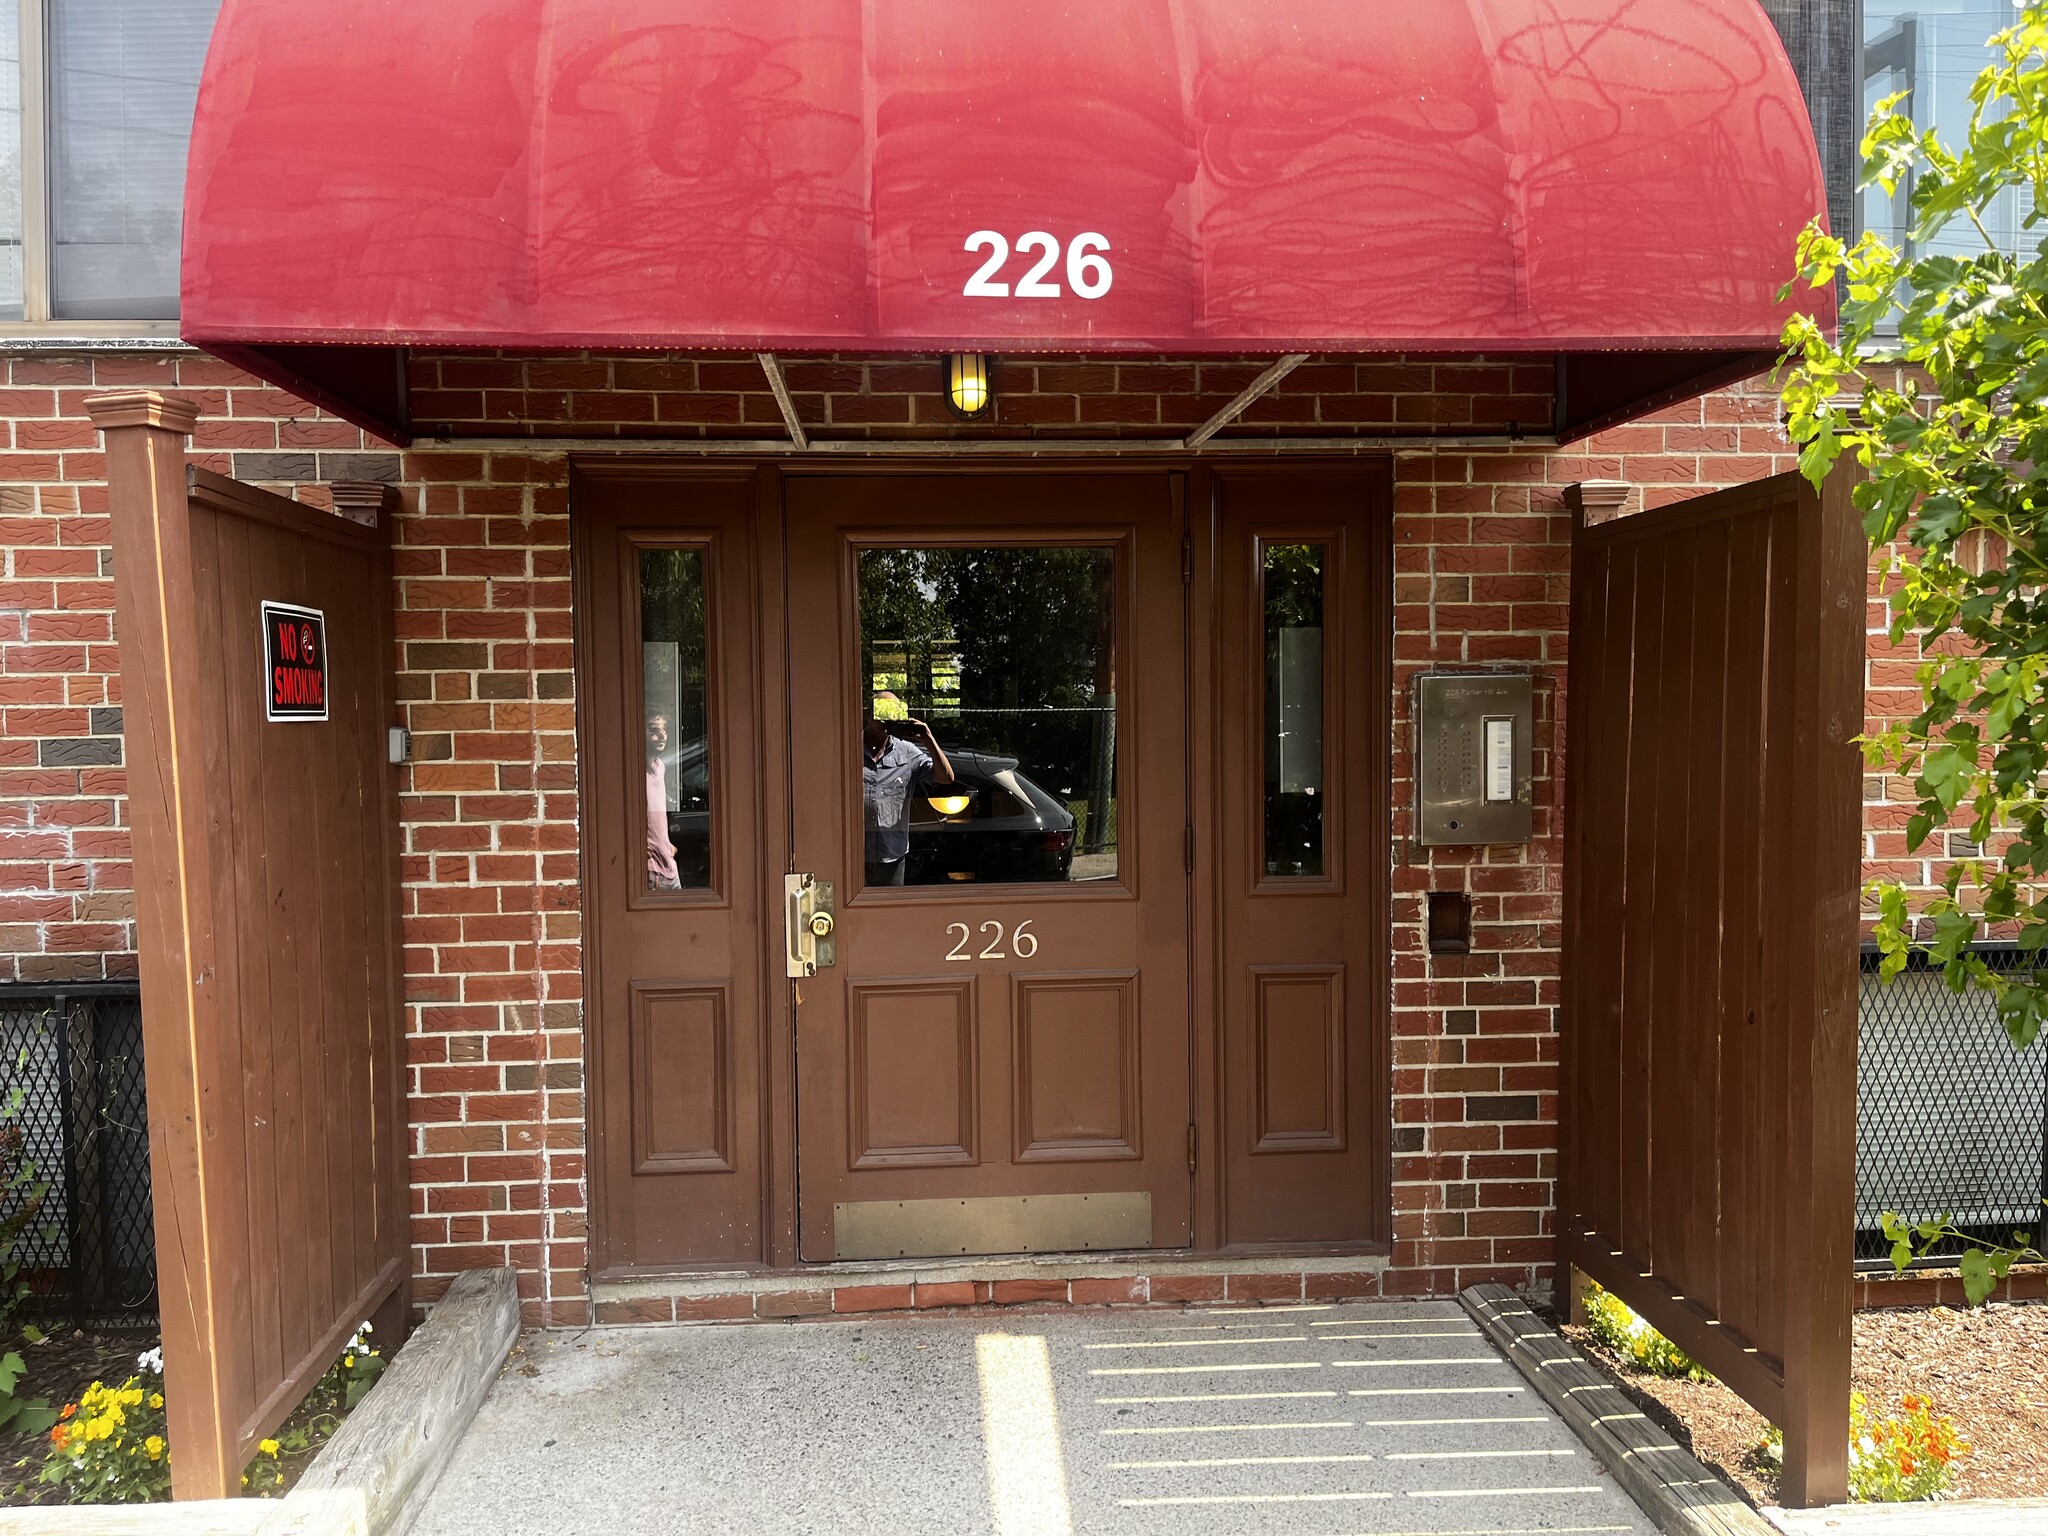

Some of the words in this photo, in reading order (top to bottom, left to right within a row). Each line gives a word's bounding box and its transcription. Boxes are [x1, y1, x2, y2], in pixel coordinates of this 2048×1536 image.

[962, 230, 1113, 299] 226
[278, 622, 297, 662] NO
[275, 666, 322, 705] SMOKING
[945, 919, 1038, 961] 226
